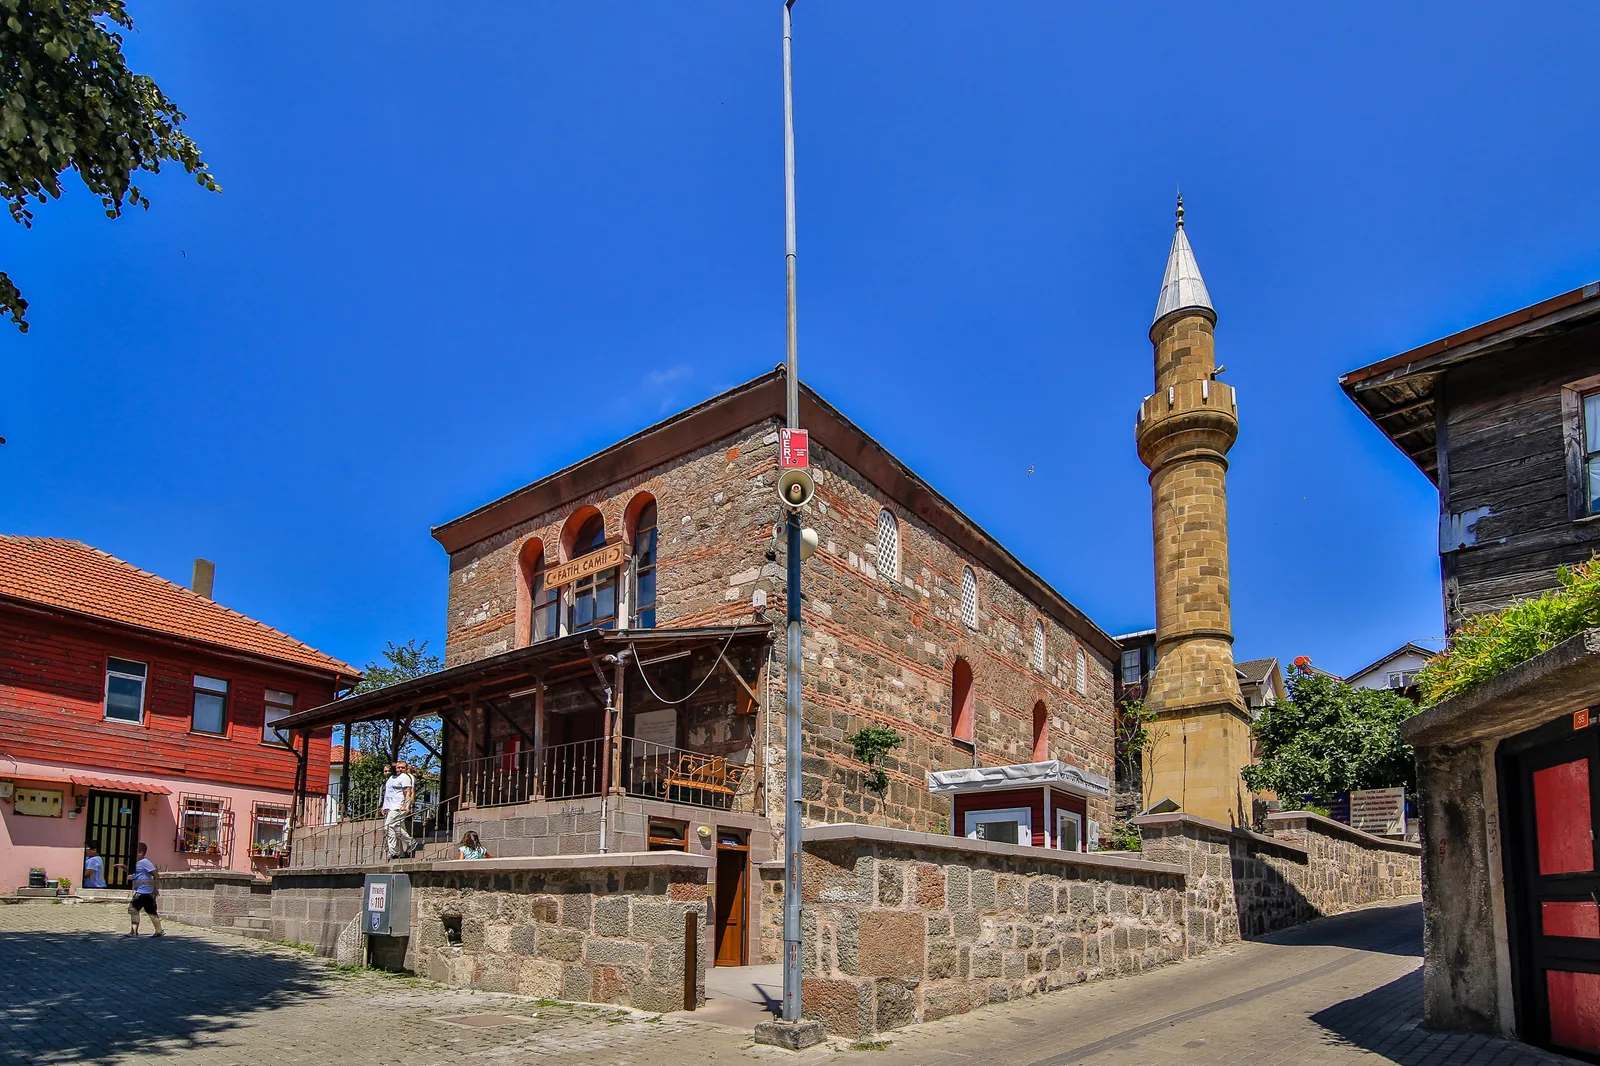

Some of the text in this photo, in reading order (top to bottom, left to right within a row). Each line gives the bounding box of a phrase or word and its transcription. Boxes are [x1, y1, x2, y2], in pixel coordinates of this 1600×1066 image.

[782, 430, 791, 465] MERT
[557, 552, 607, 581] FATİH CAMİİ
[374, 896, 385, 909] 110
